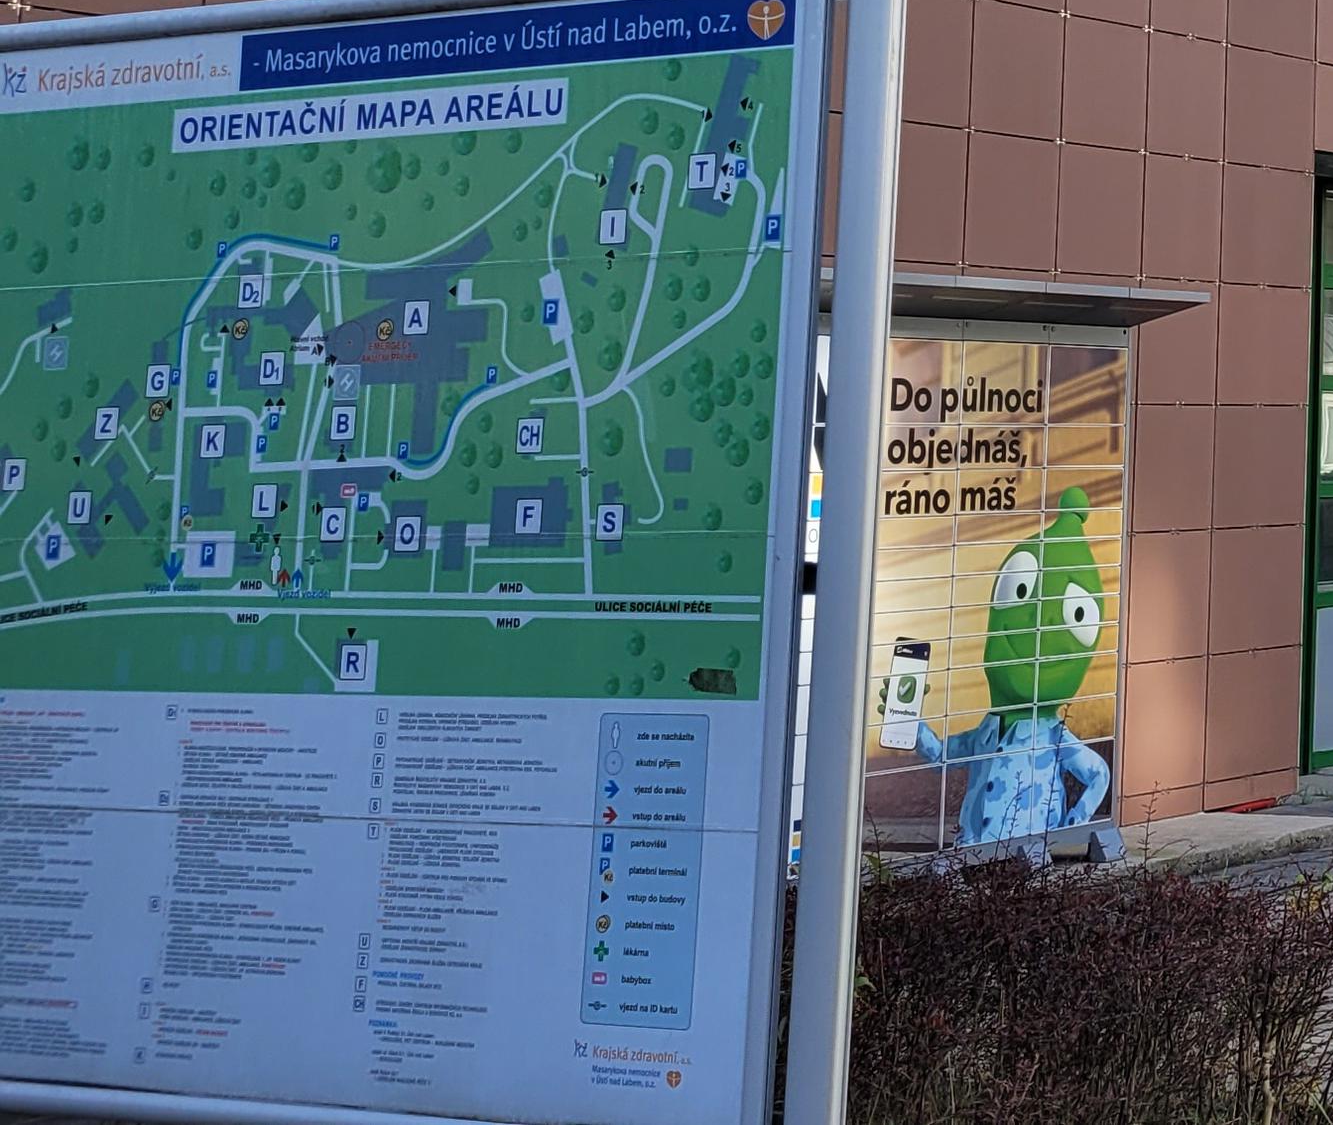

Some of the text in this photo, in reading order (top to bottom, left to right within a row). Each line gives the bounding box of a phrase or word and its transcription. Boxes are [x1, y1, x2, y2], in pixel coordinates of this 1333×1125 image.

[265, 42, 381, 73] Masarykova
[388, 30, 497, 62] nemocnice
[503, 33, 516, 52] v
[521, 19, 563, 51] Ústí
[567, 18, 606, 46] nad
[614, 14, 692, 42] Labem,
[699, 14, 737, 34] o.z.
[37, 62, 105, 95] Krajská
[209, 64, 231, 77] a.s.
[179, 84, 564, 145] ORIENTAČNÍ MAPA AREÁLU
[694, 160, 709, 183] T
[737, 162, 746, 175] P
[767, 219, 778, 235] P
[407, 307, 423, 328] A
[546, 302, 556, 319] P
[151, 371, 165, 391] G
[890, 376, 1043, 422] Do půlnoci
[100, 413, 113, 434] Z
[336, 413, 349, 434] B
[206, 431, 220, 452] K
[518, 425, 540, 447] CH
[887, 428, 1027, 475] objednáš,
[7, 465, 20, 485] P
[258, 490, 269, 512] L
[359, 495, 367, 508] P
[884, 477, 1016, 515] ráno máš
[72, 497, 86, 518] U
[326, 513, 340, 535] C
[522, 505, 535, 528] F
[602, 511, 617, 533] S
[400, 522, 415, 545] O
[49, 538, 58, 554] P
[203, 545, 213, 560] P
[240, 580, 263, 590] MHD
[499, 582, 524, 594] MHD
[18, 606, 62, 621] SOCIÁLNÍ
[63, 601, 89, 613] PÉČE
[595, 600, 713, 613] ULICE SOCIÁLNÍ PÉČE
[236, 613, 260, 623] MHD
[496, 617, 521, 628] MHD
[345, 651, 360, 673] R
[636, 732, 650, 741] zde
[661, 732, 695, 742] nacházíte
[635, 758, 681, 769] akutní příjem
[633, 786, 687, 795] vjezd do areálu
[632, 813, 686, 822] vstup do areálu
[630, 839, 667, 849] parkoviště
[628, 866, 658, 876] platební
[626, 893, 686, 906] vstup do budovy
[624, 920, 653, 931] platební
[622, 947, 649, 957] lékárna
[621, 975, 652, 986] babybox
[618, 1002, 638, 1013] vjezd
[639, 1004, 649, 1012] na
[659, 1004, 678, 1015] kartu
[592, 1044, 629, 1061] Krajská
